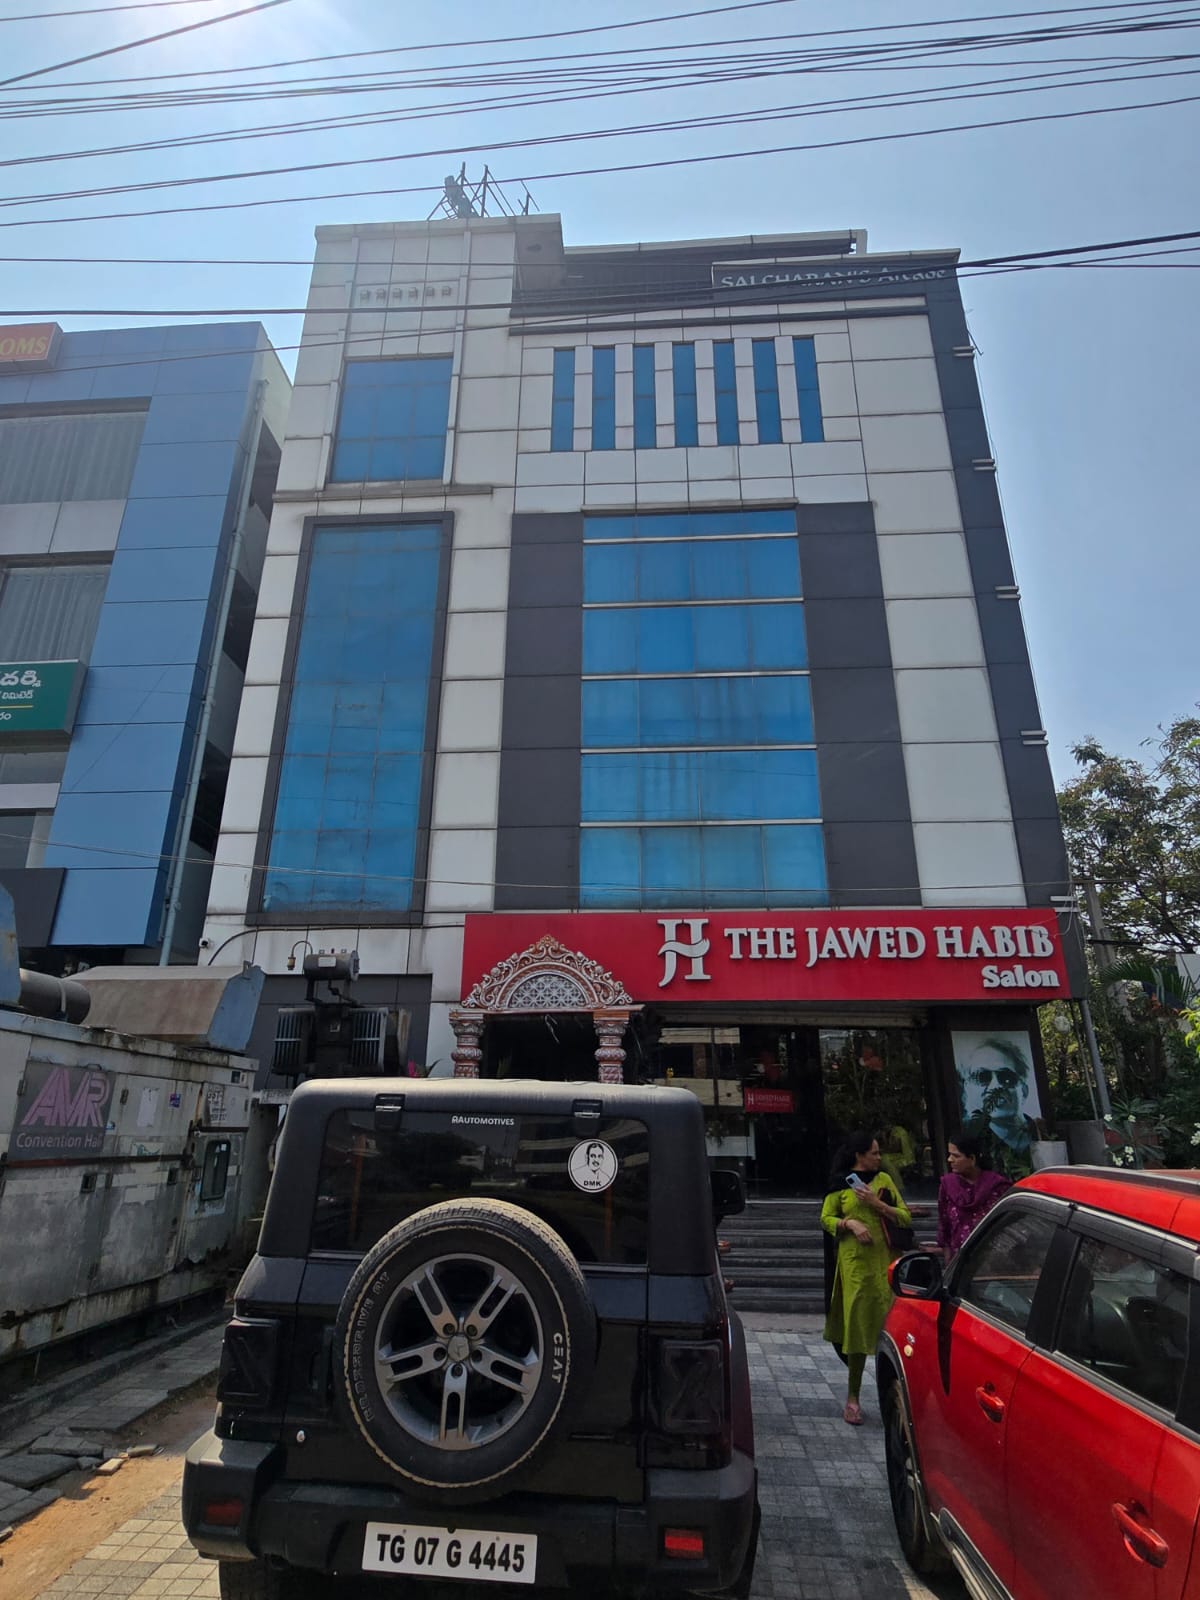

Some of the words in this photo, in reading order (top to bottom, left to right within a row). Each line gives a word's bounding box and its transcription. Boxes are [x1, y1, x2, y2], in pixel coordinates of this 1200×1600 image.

[0, 669, 41, 687] దర్శి
[724, 927, 797, 959] THE
[804, 926, 927, 968] JAWED
[934, 925, 1054, 959] HABIB
[981, 964, 1060, 988] Salon
[20, 1066, 110, 1127] AMR
[16, 1132, 81, 1149] Convention
[551, 1332, 565, 1384] CEAT
[376, 1533, 405, 1563] TG
[414, 1537, 440, 1566] 07
[446, 1540, 462, 1568] G
[469, 1541, 525, 1573] 4445
